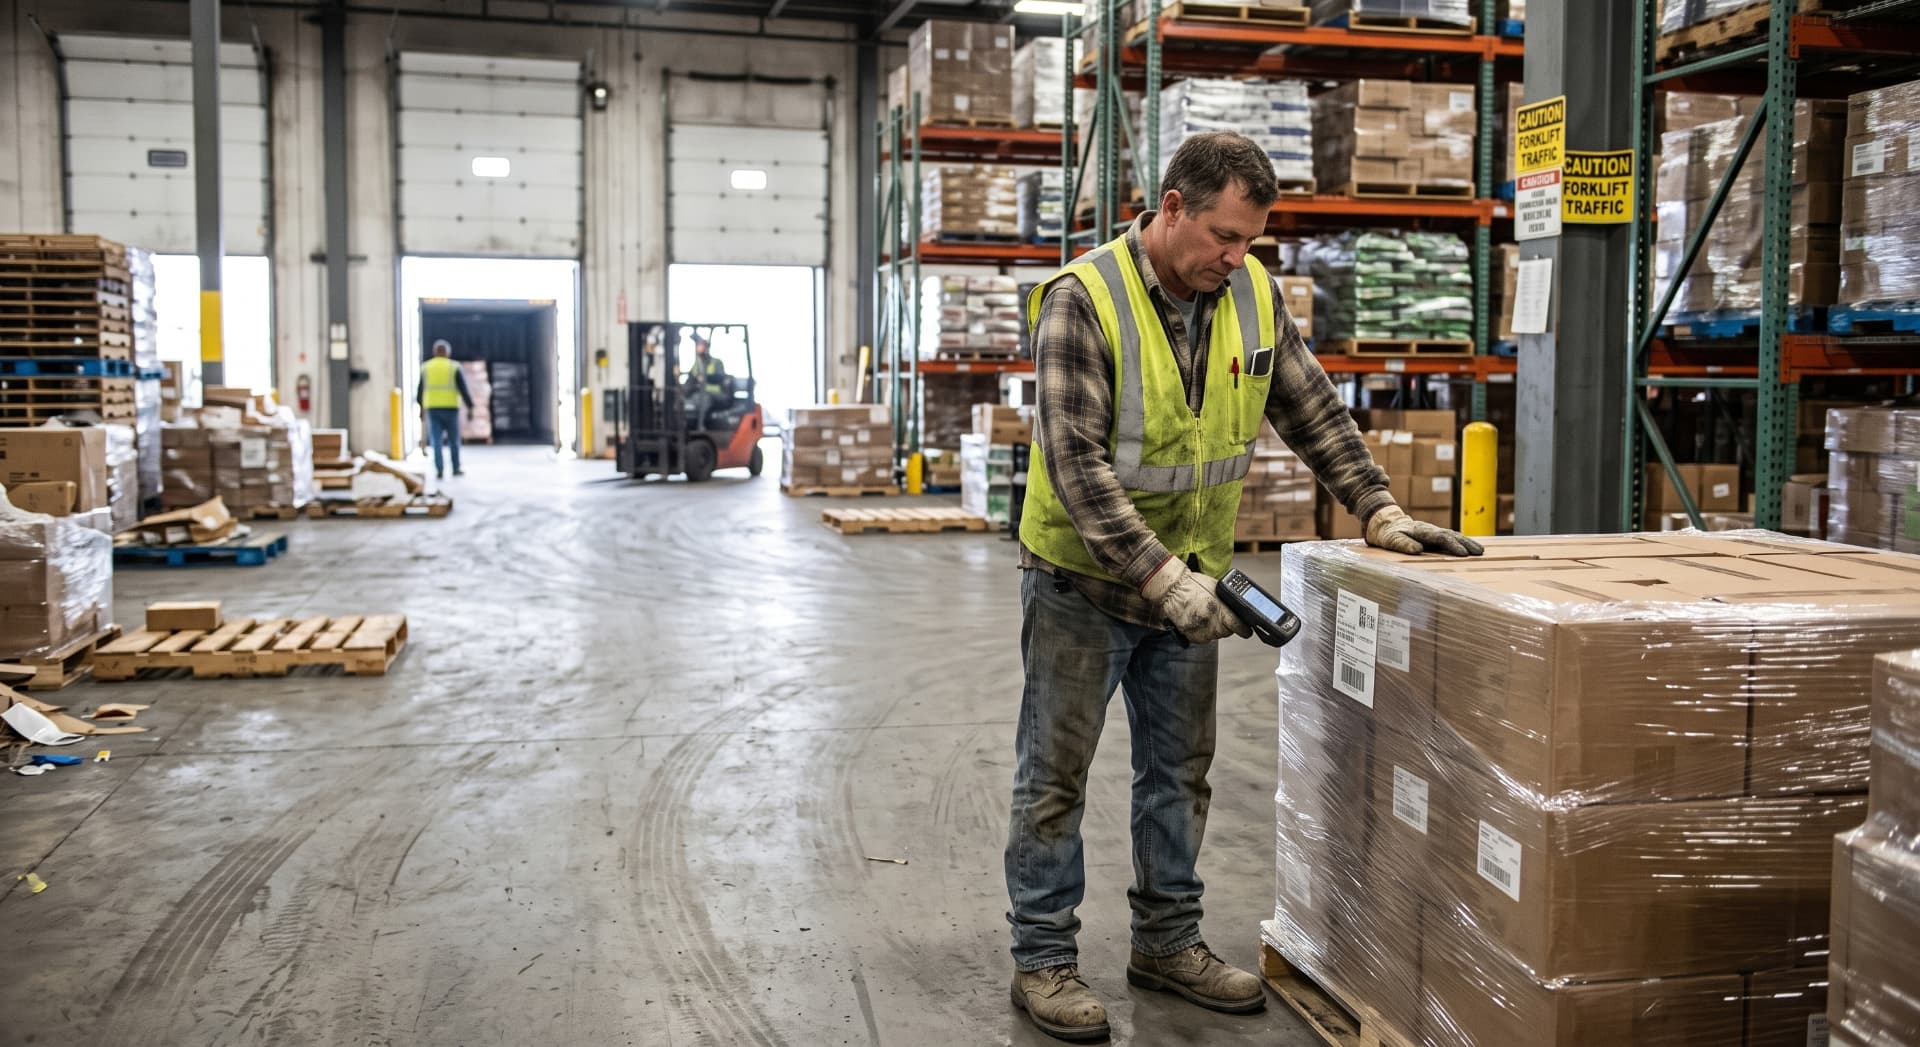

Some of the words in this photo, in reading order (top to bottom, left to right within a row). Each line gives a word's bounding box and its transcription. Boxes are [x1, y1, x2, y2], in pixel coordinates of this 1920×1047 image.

[1519, 103, 1562, 130] CAUTION
[1519, 128, 1560, 150] FORKLIFT
[1521, 147, 1557, 167] TRAFFIC
[1564, 157, 1630, 175] CAUTION
[1564, 181, 1629, 196] FORKLIFT
[1566, 200, 1624, 214] TRAFFIC
